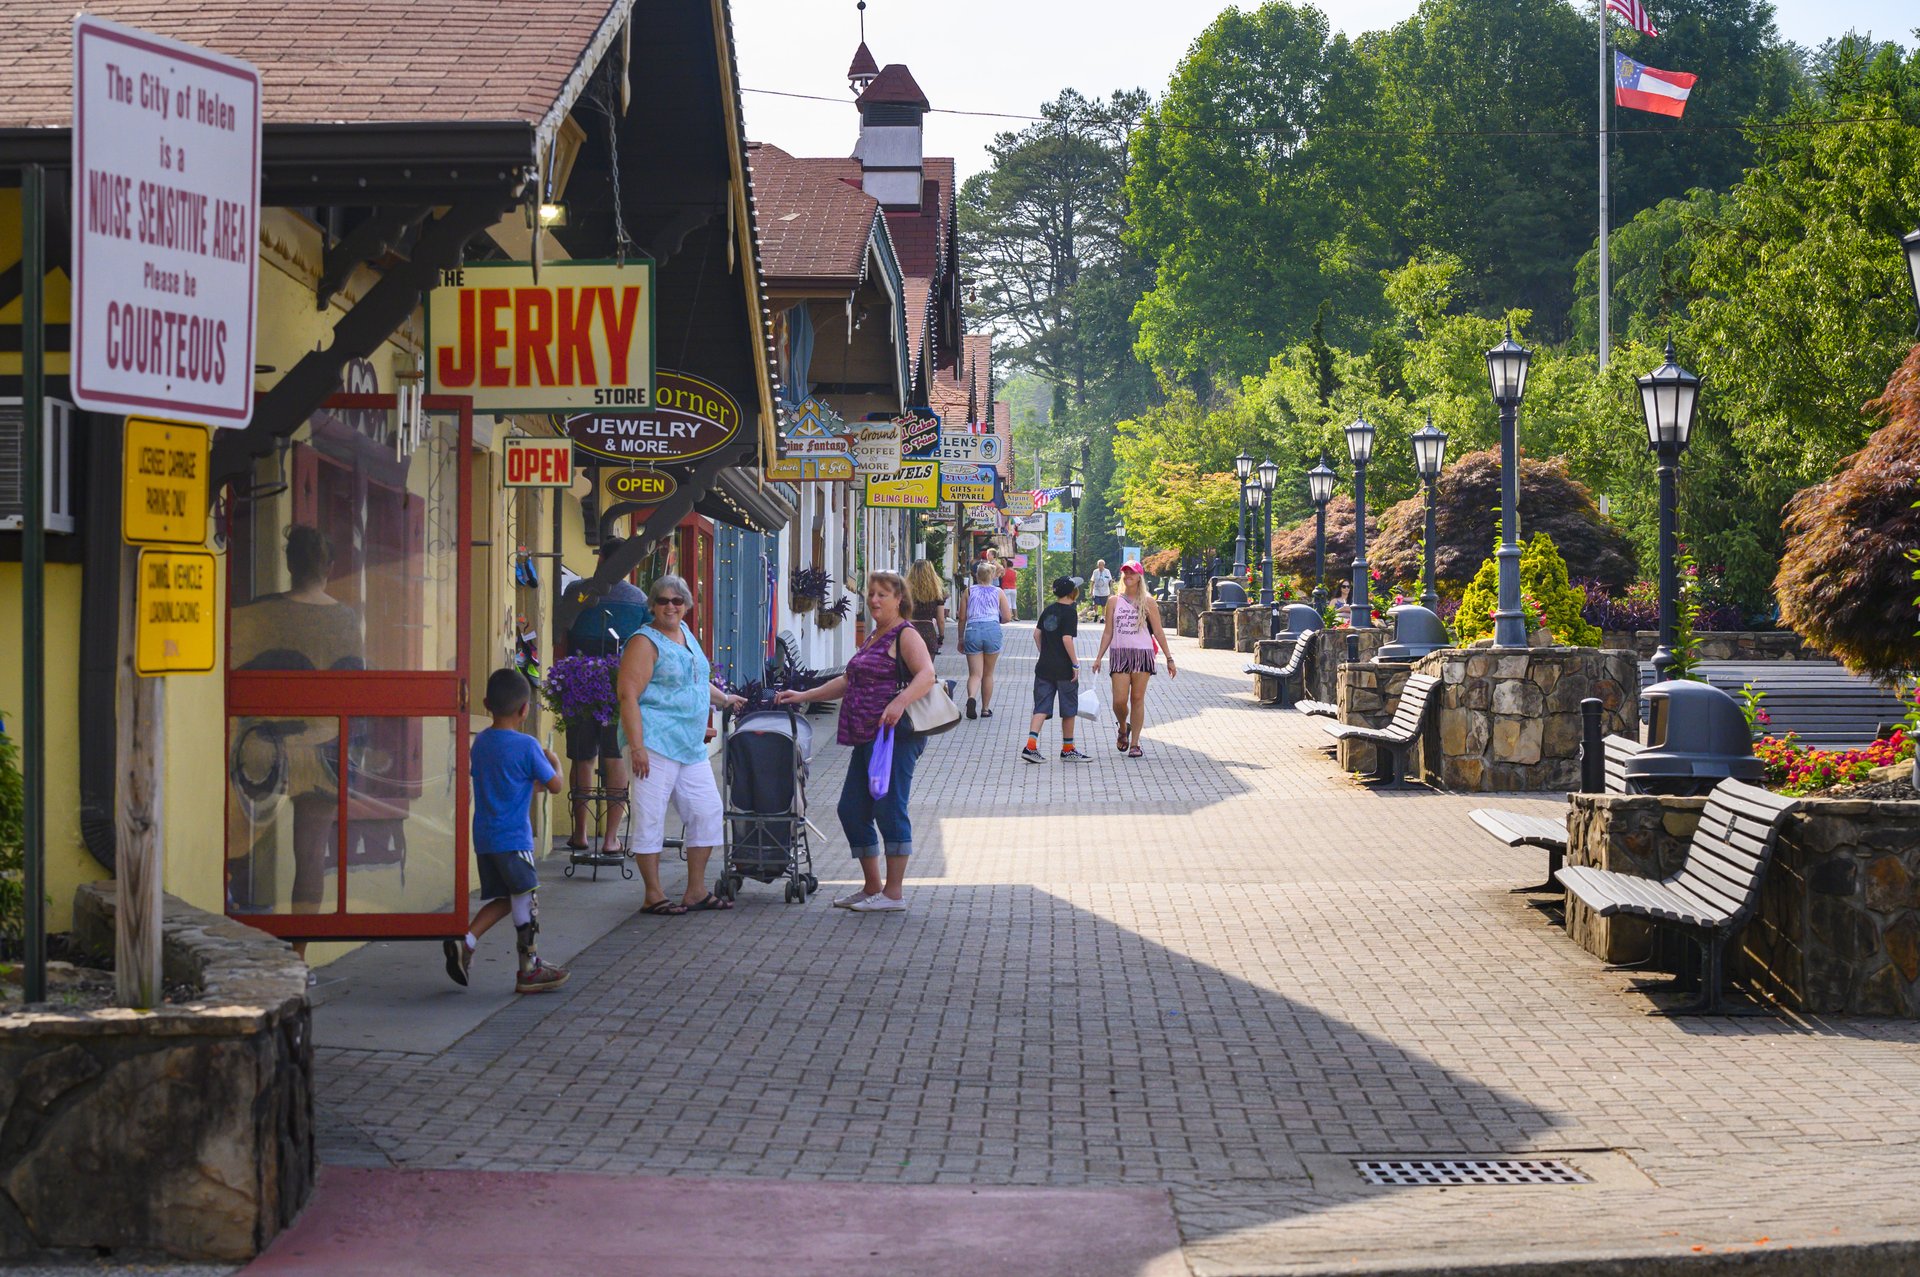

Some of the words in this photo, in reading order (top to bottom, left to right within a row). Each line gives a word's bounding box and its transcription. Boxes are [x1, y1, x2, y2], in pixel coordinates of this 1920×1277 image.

[106, 63, 133, 105] The
[140, 72, 170, 121] City
[176, 85, 191, 119] of
[198, 88, 235, 132] Helen
[160, 136, 171, 170] is
[178, 147, 185, 172] a
[89, 169, 132, 240] NOISE
[138, 180, 208, 256] SENSITIVE
[212, 198, 246, 264] AREA
[144, 261, 180, 295] Please
[183, 269, 196, 298] be
[106, 301, 227, 385] COURTEOUS
[438, 286, 641, 388] JERKY
[594, 388, 646, 405] STORE
[656, 387, 730, 425] orner
[586, 418, 702, 438] JEWELRY
[861, 427, 898, 442] Ground
[605, 438, 616, 452] &
[786, 440, 804, 451] pine
[807, 439, 847, 452] Fantasy
[939, 436, 978, 447] ELEN'S
[855, 447, 895, 455] COFFEE
[933, 449, 971, 459] BEST
[508, 448, 568, 482] OPEN
[617, 477, 665, 493] OPEN
[874, 493, 901, 503] BLING
[903, 494, 929, 504] BLING
[950, 492, 985, 500] APPAREL
